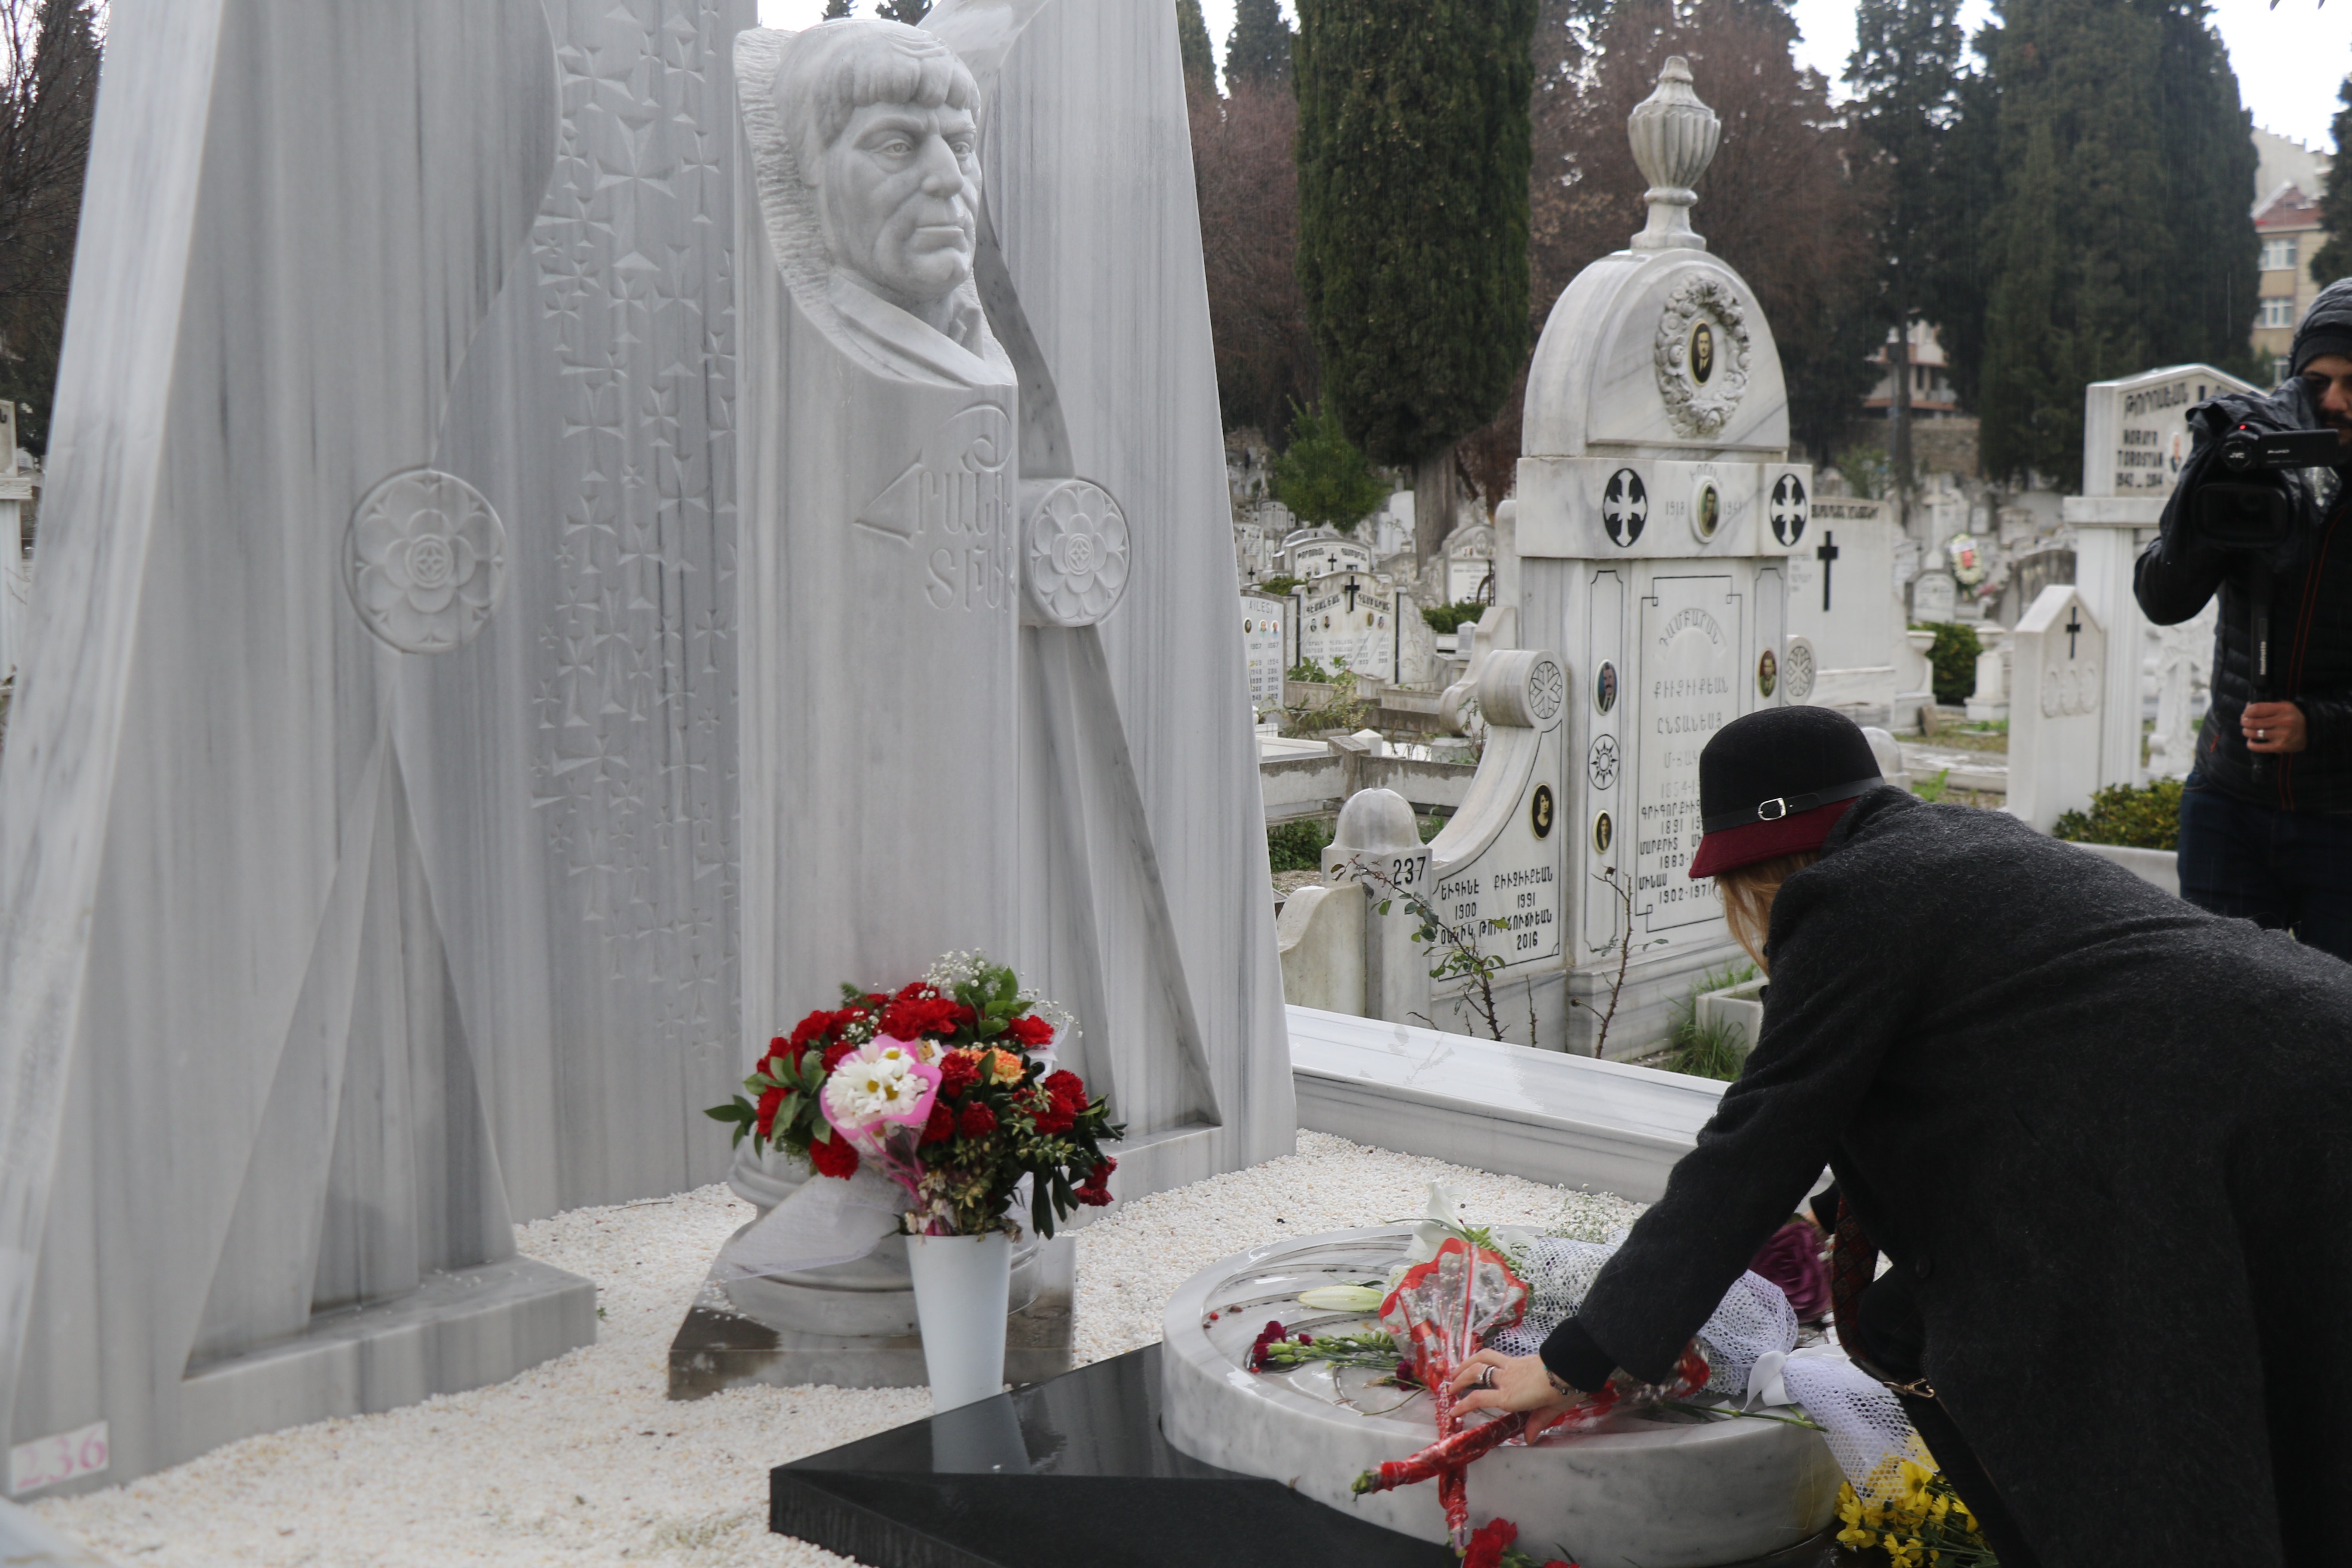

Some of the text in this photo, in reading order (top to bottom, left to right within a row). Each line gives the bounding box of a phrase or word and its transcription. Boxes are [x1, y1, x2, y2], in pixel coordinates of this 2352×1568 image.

[1642, 802, 1677, 820] ԳՐԻԳՈՐ
[1661, 815, 1702, 835] 1891 19
[1660, 851, 1694, 869] 1883-1
[1393, 856, 1427, 885] 237
[1639, 873, 1668, 890] ՄԻՆԱՍ
[1455, 891, 1536, 921] 1900 1991
[1516, 931, 1538, 951] 2016
